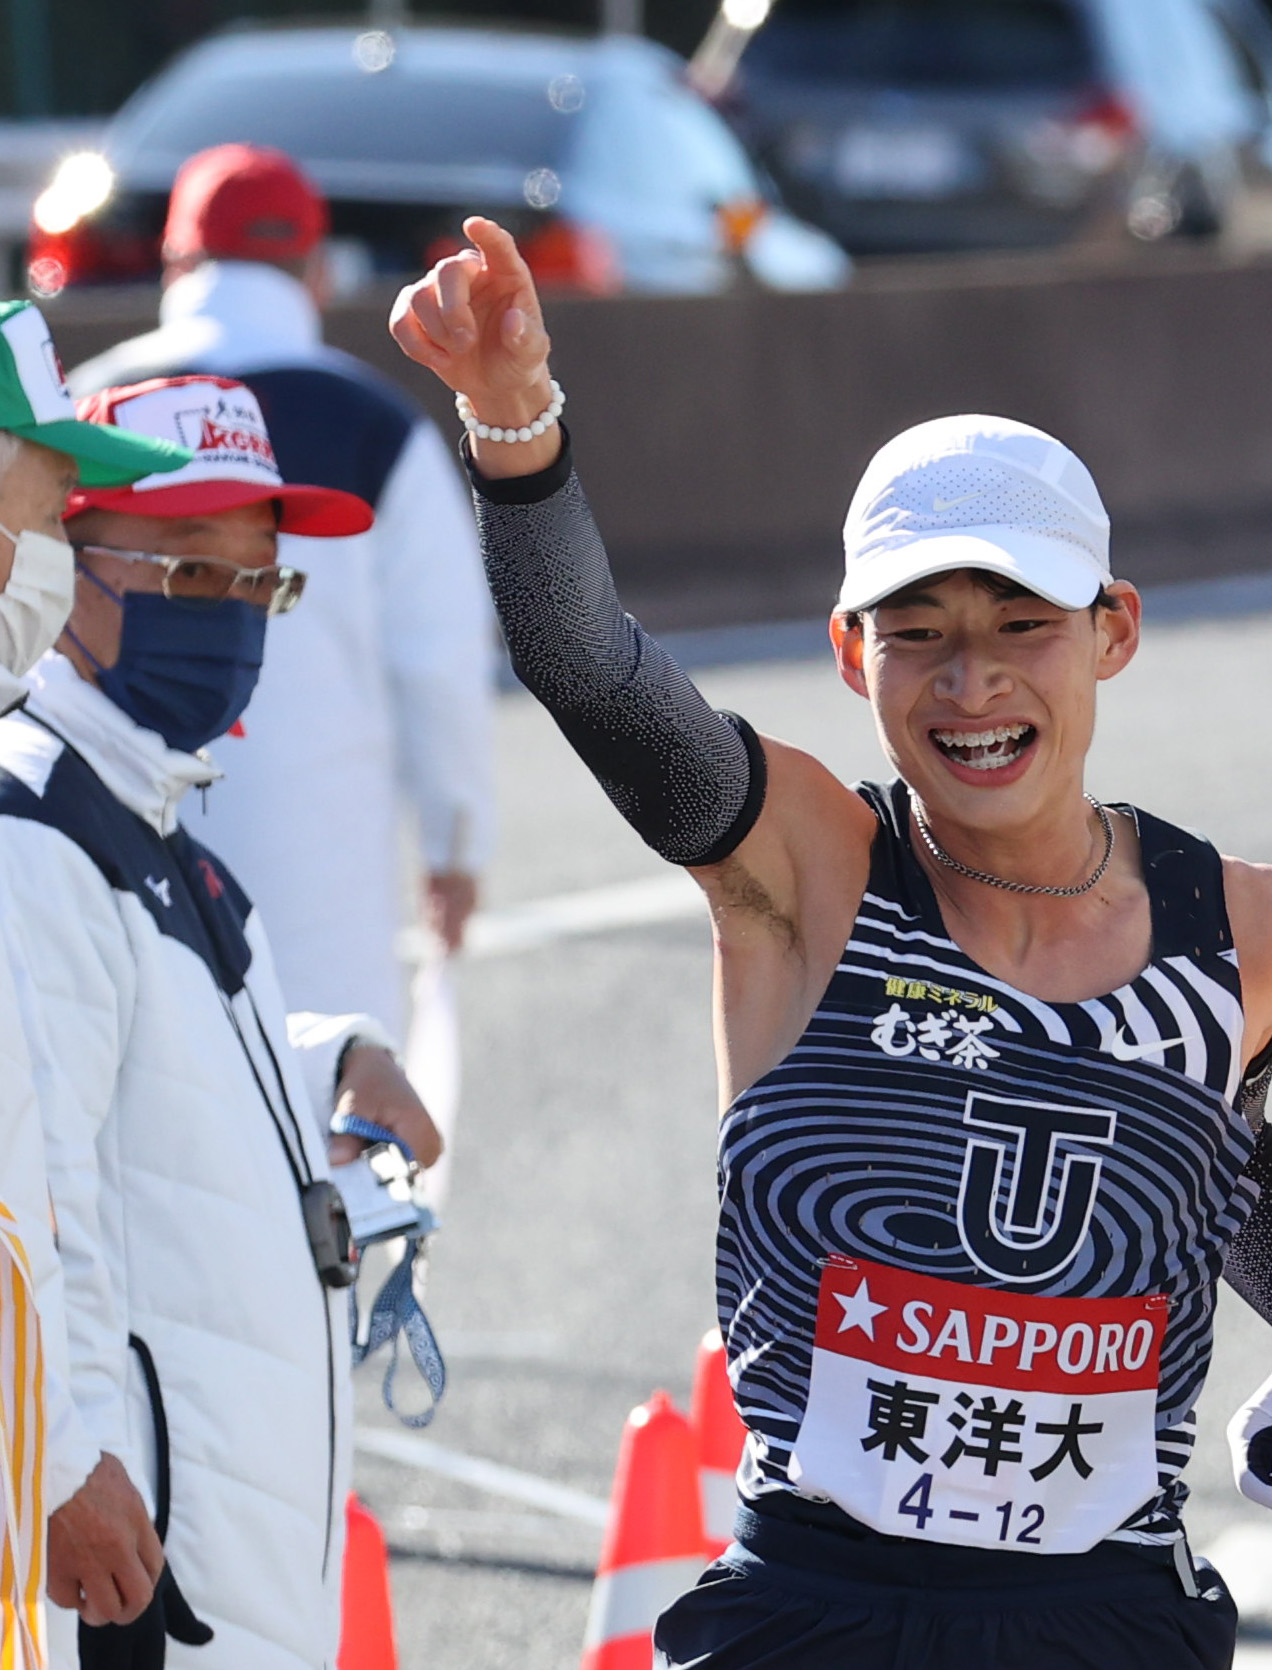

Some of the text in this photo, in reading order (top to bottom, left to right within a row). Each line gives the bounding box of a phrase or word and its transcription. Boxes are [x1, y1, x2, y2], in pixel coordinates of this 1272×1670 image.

[885, 977, 999, 1013] 健康ミネラル
[870, 1002, 1001, 1070] むぎ茶
[896, 1300, 1154, 1374] SAPPORO
[860, 1377, 1104, 1482] 東洋大
